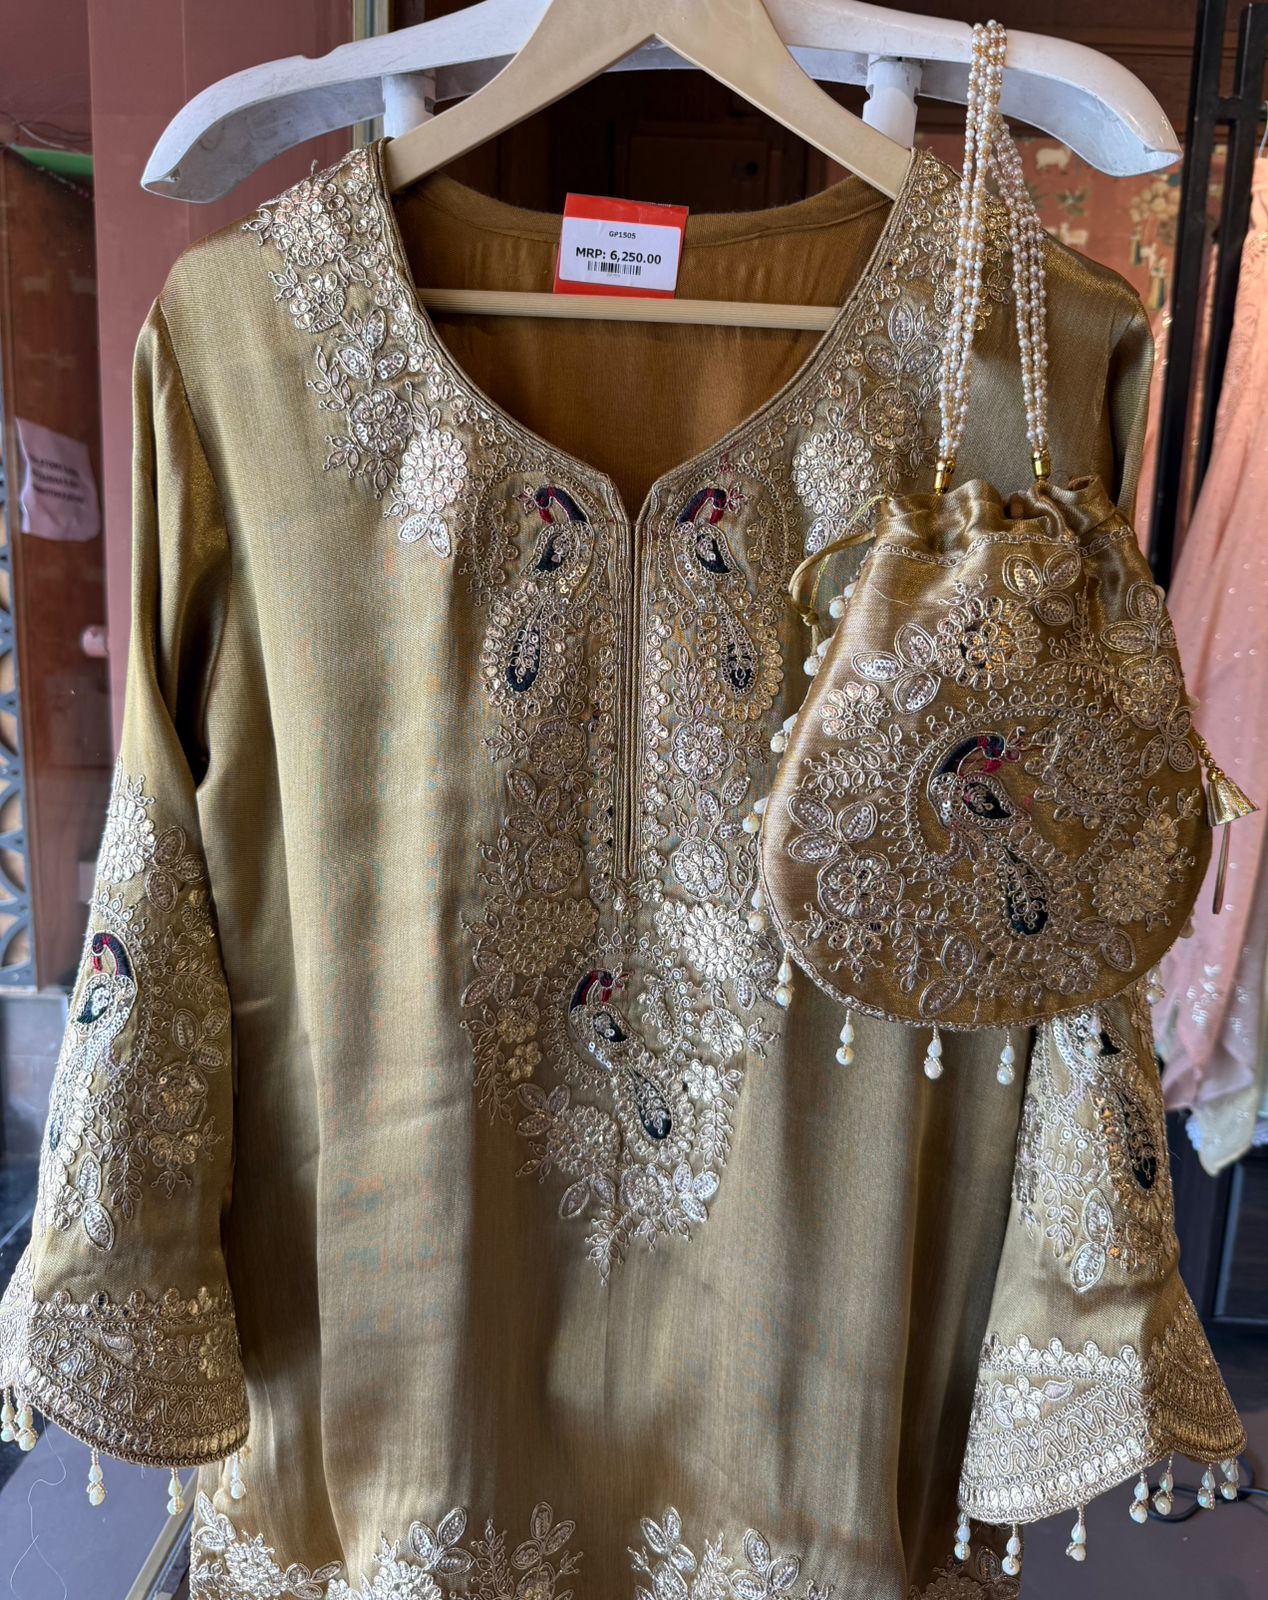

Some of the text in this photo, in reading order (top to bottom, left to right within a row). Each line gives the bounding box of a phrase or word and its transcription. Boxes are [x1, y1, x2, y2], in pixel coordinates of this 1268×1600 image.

[608, 230, 637, 240] GP1505
[575, 246, 662, 265] MRP: 6,250.00
